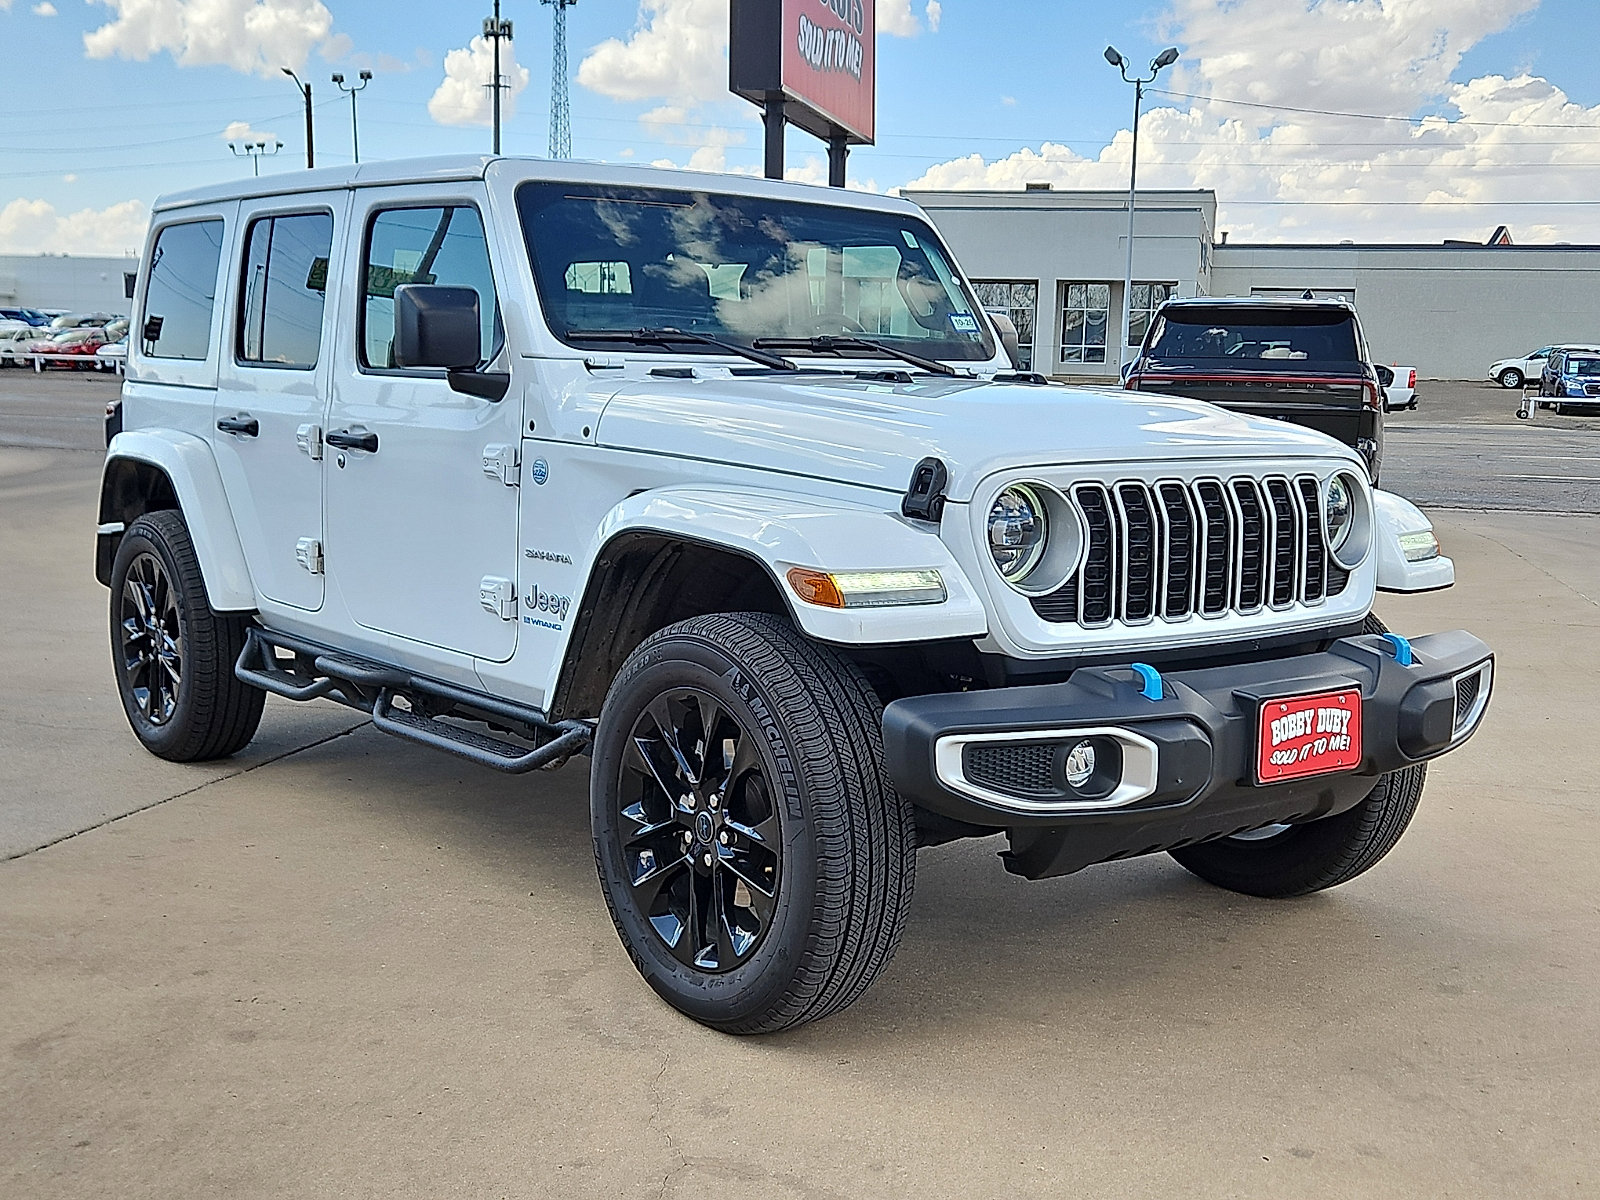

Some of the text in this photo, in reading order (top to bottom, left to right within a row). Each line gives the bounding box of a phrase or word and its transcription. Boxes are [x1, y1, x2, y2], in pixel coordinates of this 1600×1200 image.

[798, 13, 824, 69] SOLD
[823, 28, 835, 69] IT
[834, 28, 846, 69] TO
[845, 32, 863, 79] ME!
[1185, 379, 1316, 389] LINCOLN
[525, 549, 573, 565] SAHARA
[525, 584, 571, 621] Jeep
[1270, 708, 1352, 746] BOBBY DUBY
[750, 696, 803, 818] MICHELIN
[1269, 735, 1352, 766] SOLD IT TO ME!
